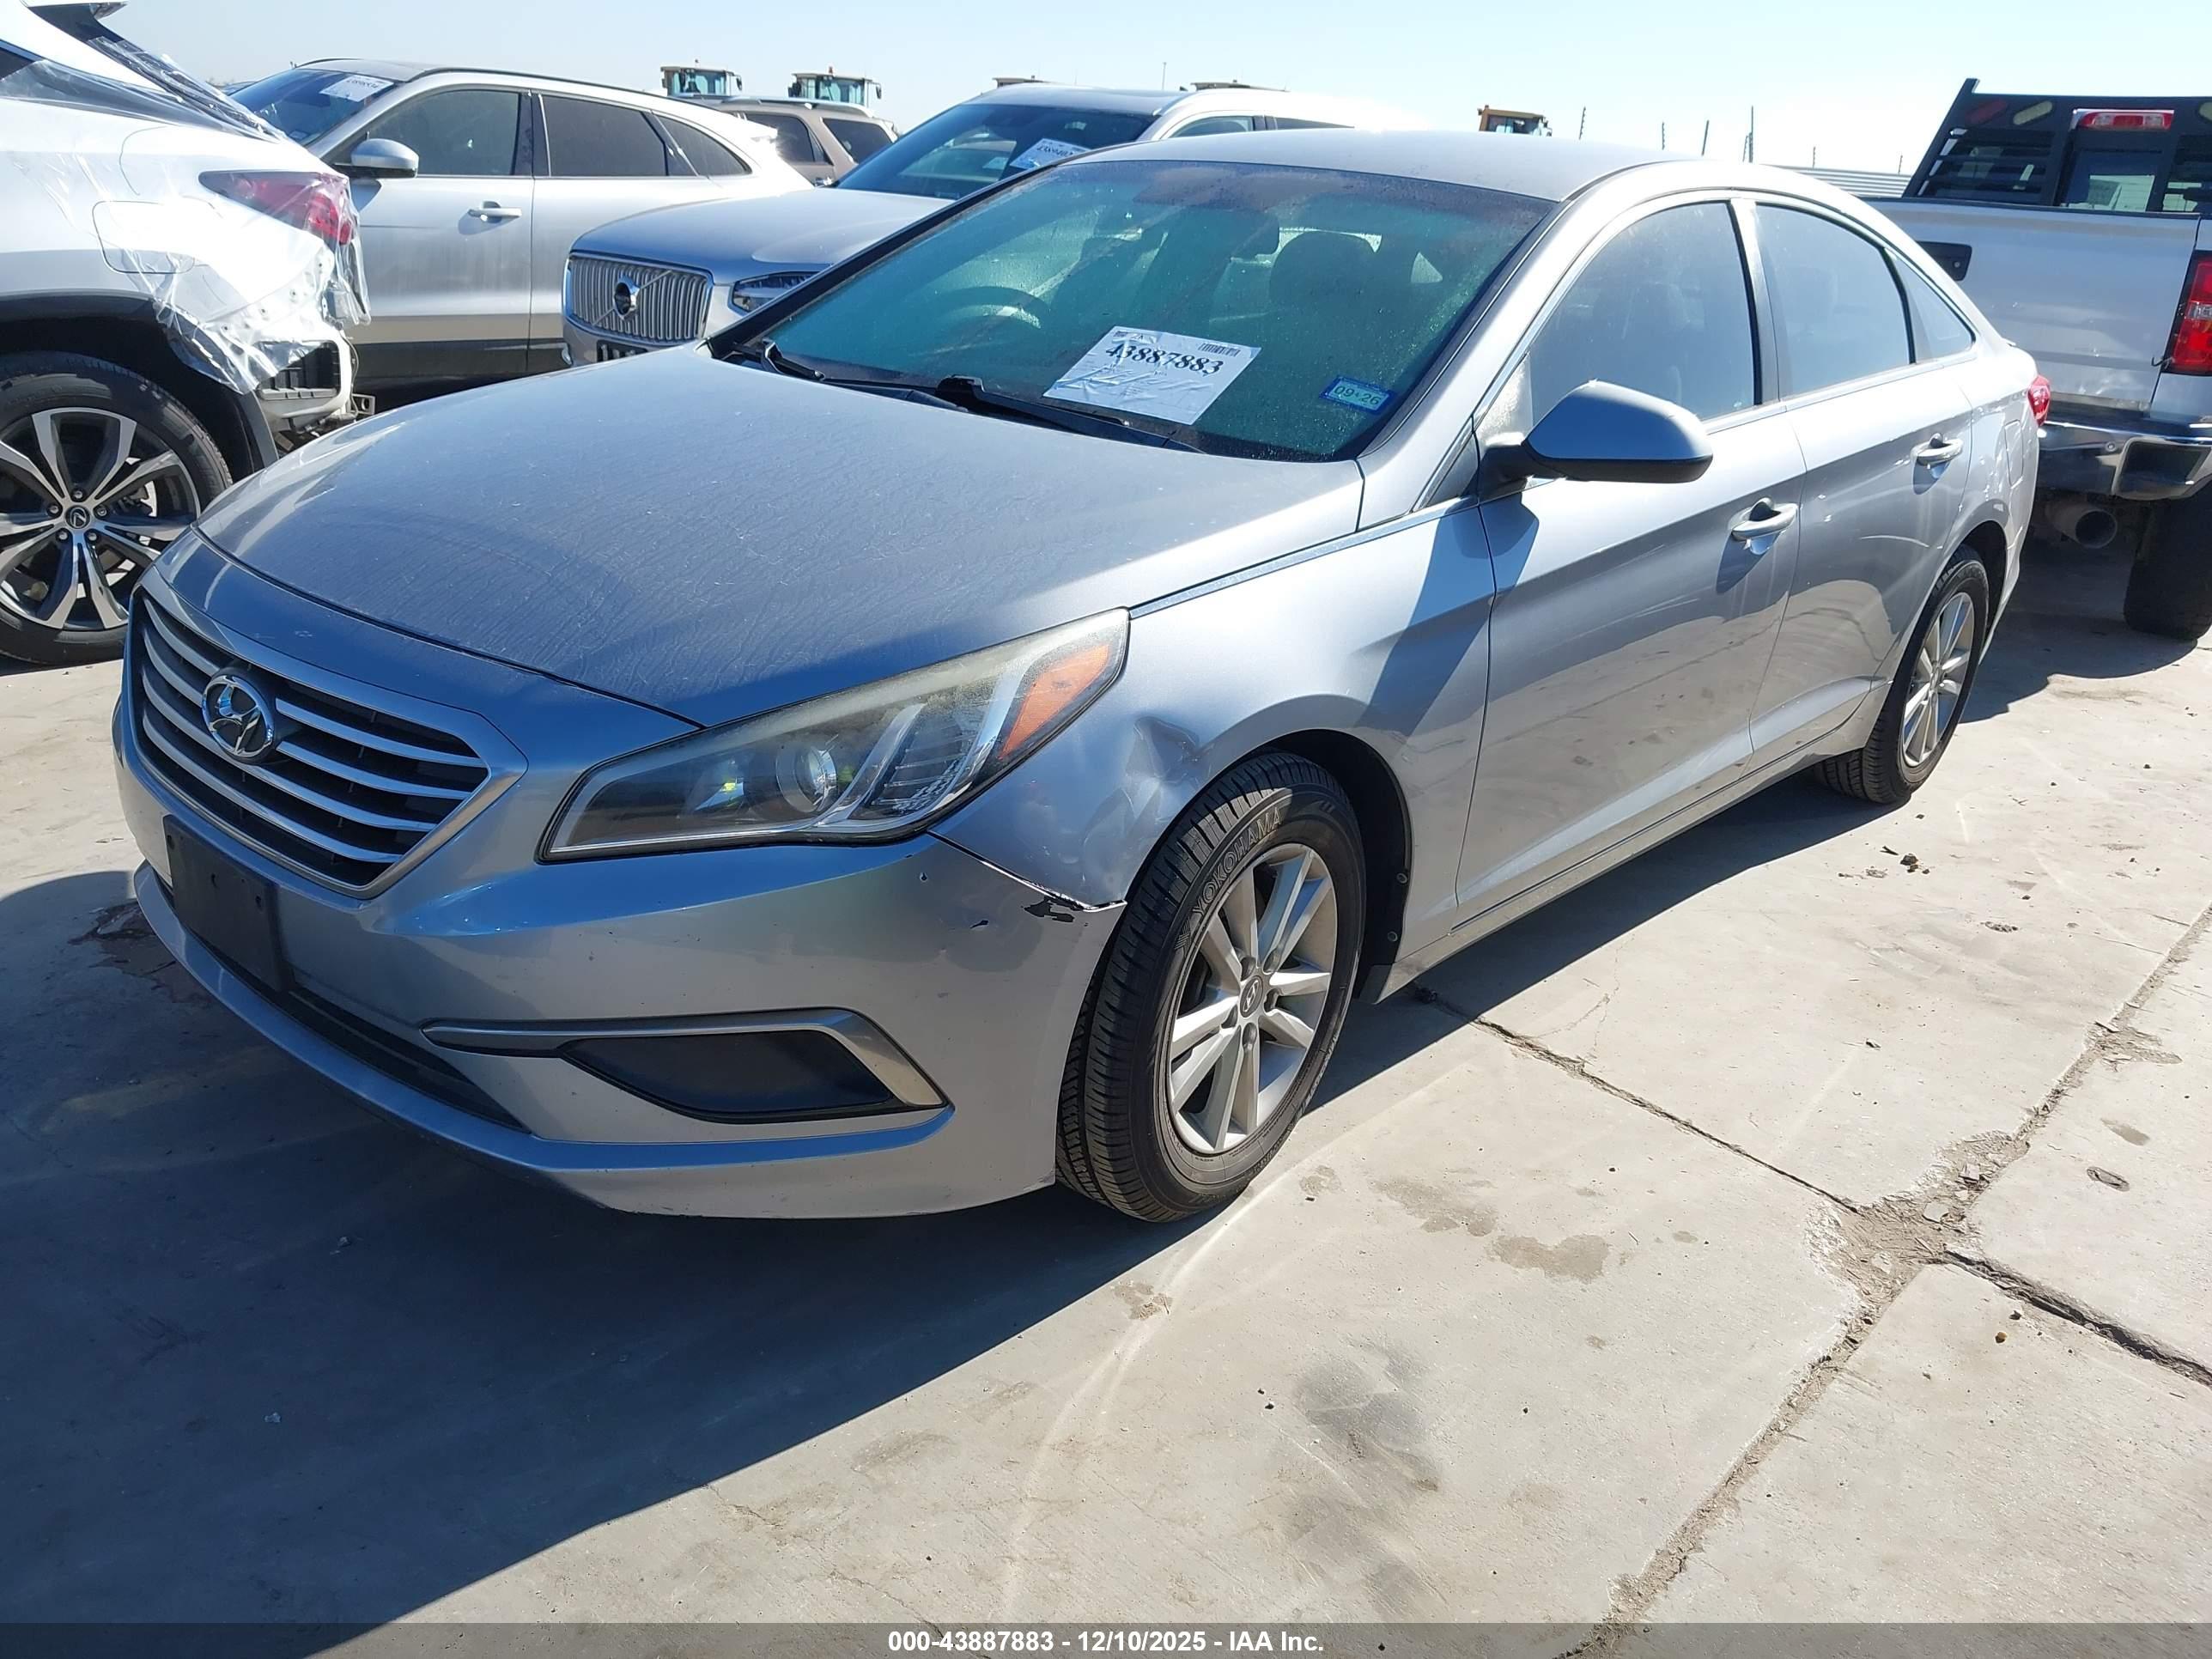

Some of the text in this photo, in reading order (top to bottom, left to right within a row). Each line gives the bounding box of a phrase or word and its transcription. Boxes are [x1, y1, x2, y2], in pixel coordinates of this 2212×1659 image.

[1105, 343, 1224, 375] 43887883
[1334, 386, 1382, 405] 09 26
[1192, 807, 1281, 915] YOKOHAMA
